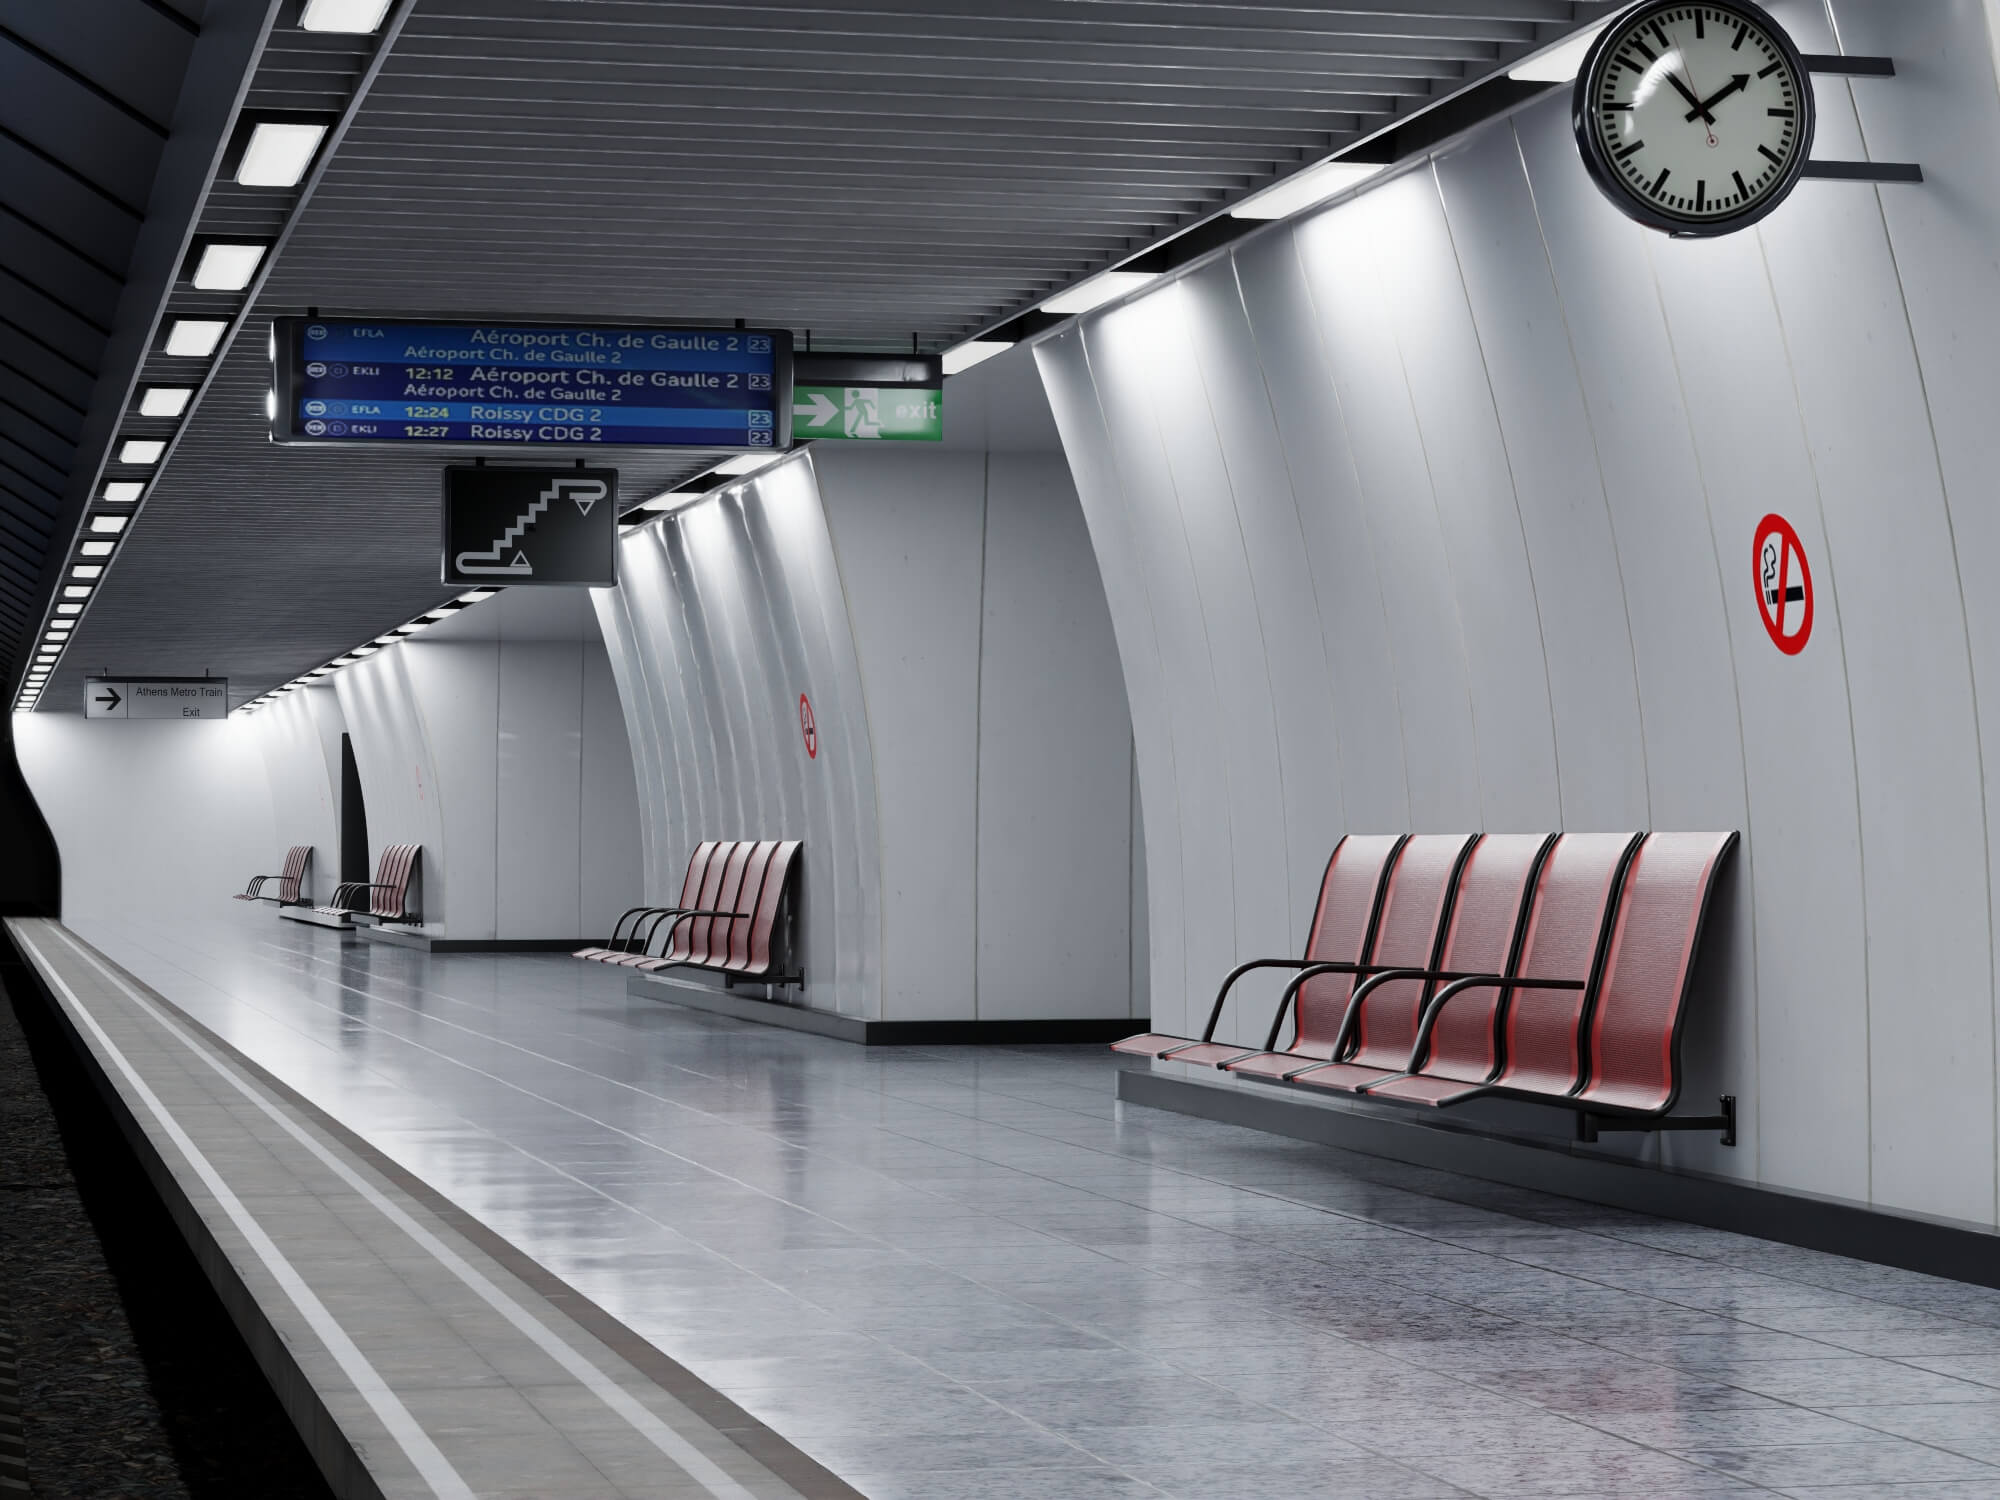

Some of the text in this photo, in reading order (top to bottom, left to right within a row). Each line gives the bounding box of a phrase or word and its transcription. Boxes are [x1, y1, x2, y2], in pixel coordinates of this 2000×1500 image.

[353, 328, 769, 351] EFLA Aéroport Ch. de Gaulle 2 23
[404, 345, 622, 364] Aéroport Ch. de Gaulle 2
[405, 367, 454, 380] 12:12
[469, 366, 569, 385] Aéroport
[576, 370, 611, 385] Ch.
[618, 371, 644, 386] de
[651, 372, 720, 388] Gaulle
[726, 374, 739, 388] 2
[750, 376, 769, 388] 23
[403, 383, 622, 401] Aéroport Ch. de Gaulle 2
[352, 404, 770, 424] EFLA 12:24 Roissy CDG 2 23
[895, 401, 936, 419] exit
[404, 425, 449, 437] 12:27
[471, 424, 533, 442] Roissy
[538, 426, 584, 441] CDG
[590, 428, 602, 441] 2
[751, 432, 770, 443] 23
[136, 686, 223, 697] Athens Metro Train
[183, 707, 200, 717] Exit
